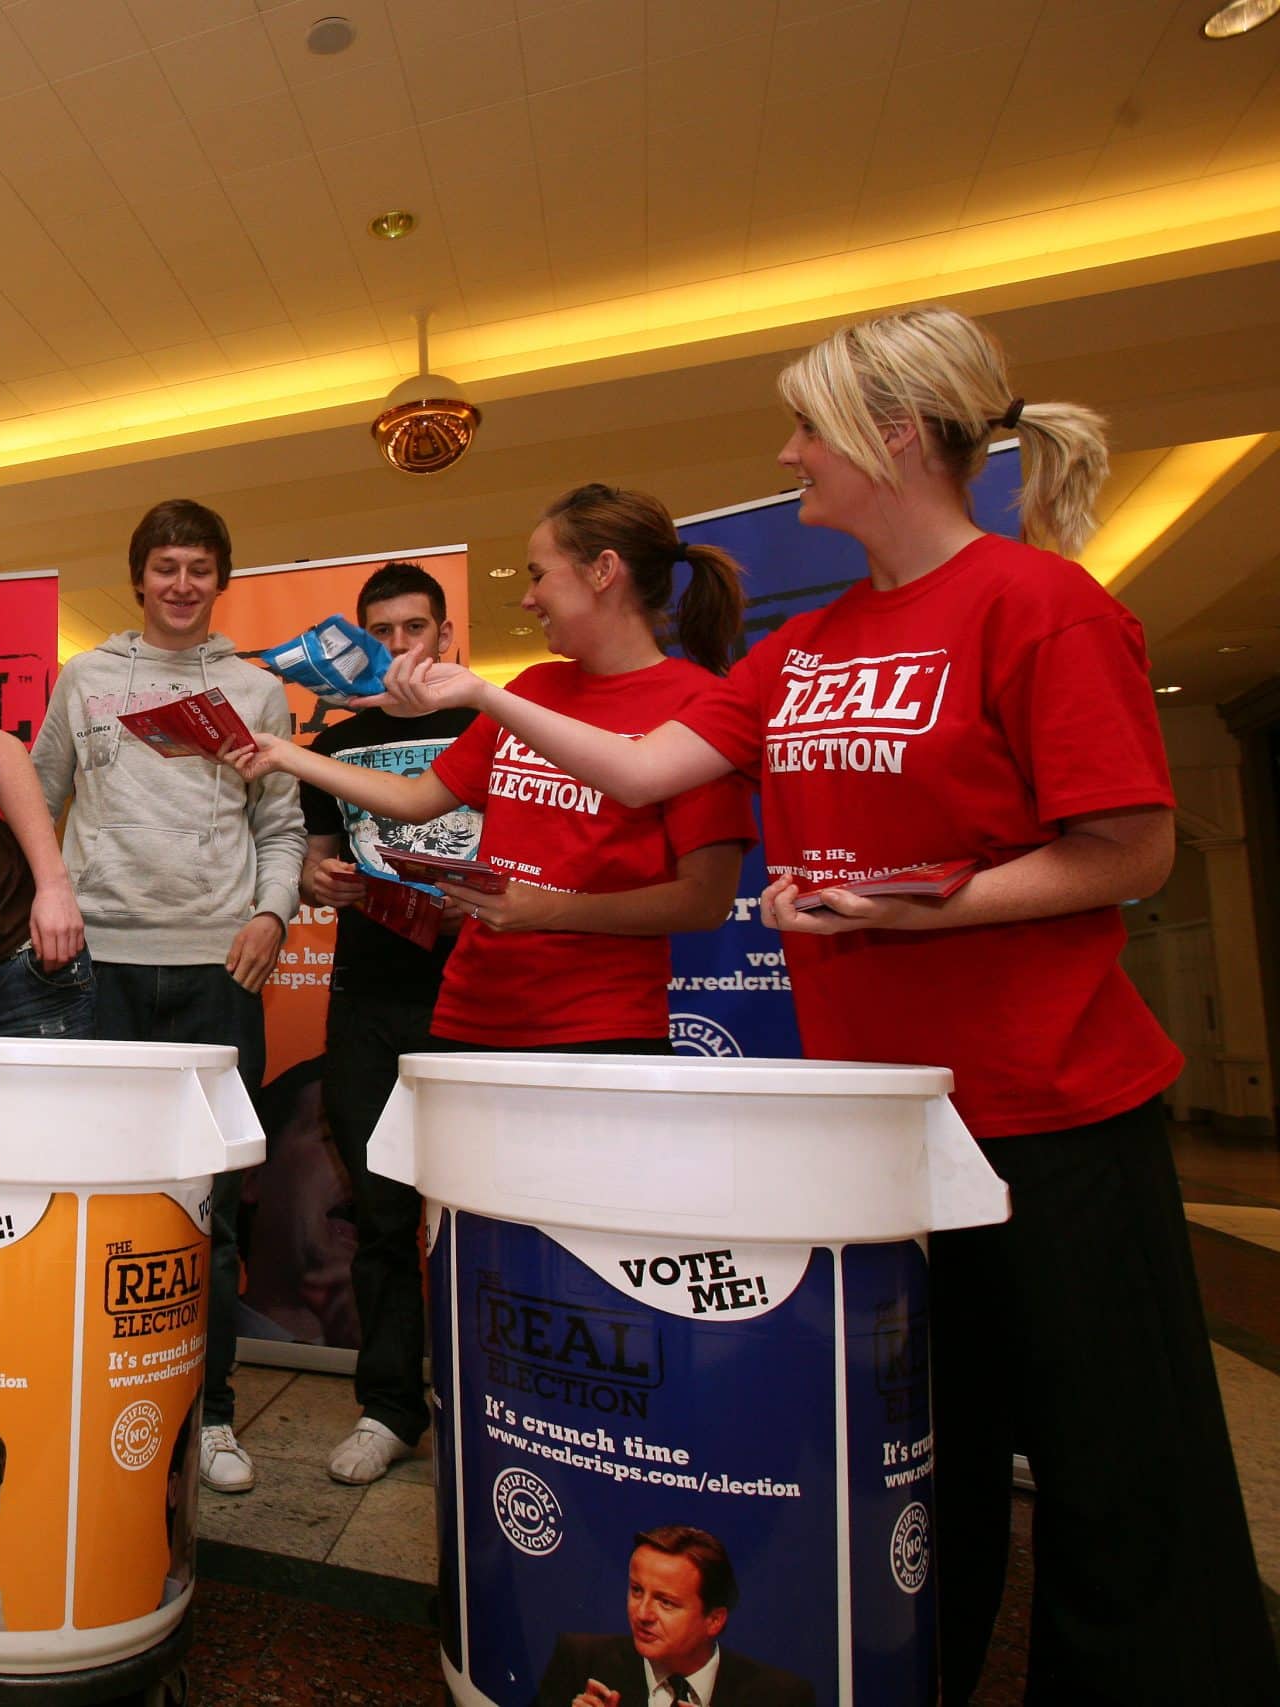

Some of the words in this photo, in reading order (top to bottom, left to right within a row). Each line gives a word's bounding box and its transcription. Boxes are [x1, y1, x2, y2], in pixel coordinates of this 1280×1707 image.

[784, 648, 823, 668] THE
[767, 664, 920, 727] REAL
[518, 862, 542, 876] HERE
[106, 1240, 132, 1255] THE
[115, 1253, 200, 1306] REAL
[620, 1249, 737, 1288] VOTE
[687, 1276, 769, 1314] ME!
[113, 1301, 200, 1338] ELECTION
[108, 1350, 137, 1371] It's
[142, 1339, 188, 1367] crunch
[487, 1297, 649, 1378] REAL
[488, 1356, 649, 1419] ELECTION
[115, 1405, 159, 1440] ARTIFICIAL
[130, 1426, 150, 1444] NO
[485, 1395, 517, 1426] It's
[522, 1415, 615, 1453] crunch
[624, 1436, 690, 1466] time
[121, 1437, 159, 1465] POLICIES
[487, 1423, 801, 1498] www.realcrisps.com/election
[883, 1440, 909, 1466] It's
[498, 1474, 556, 1513] ARTIFICIAL
[512, 1499, 540, 1521] NO
[504, 1518, 557, 1549] POLICIES
[906, 1535, 921, 1558] NO
